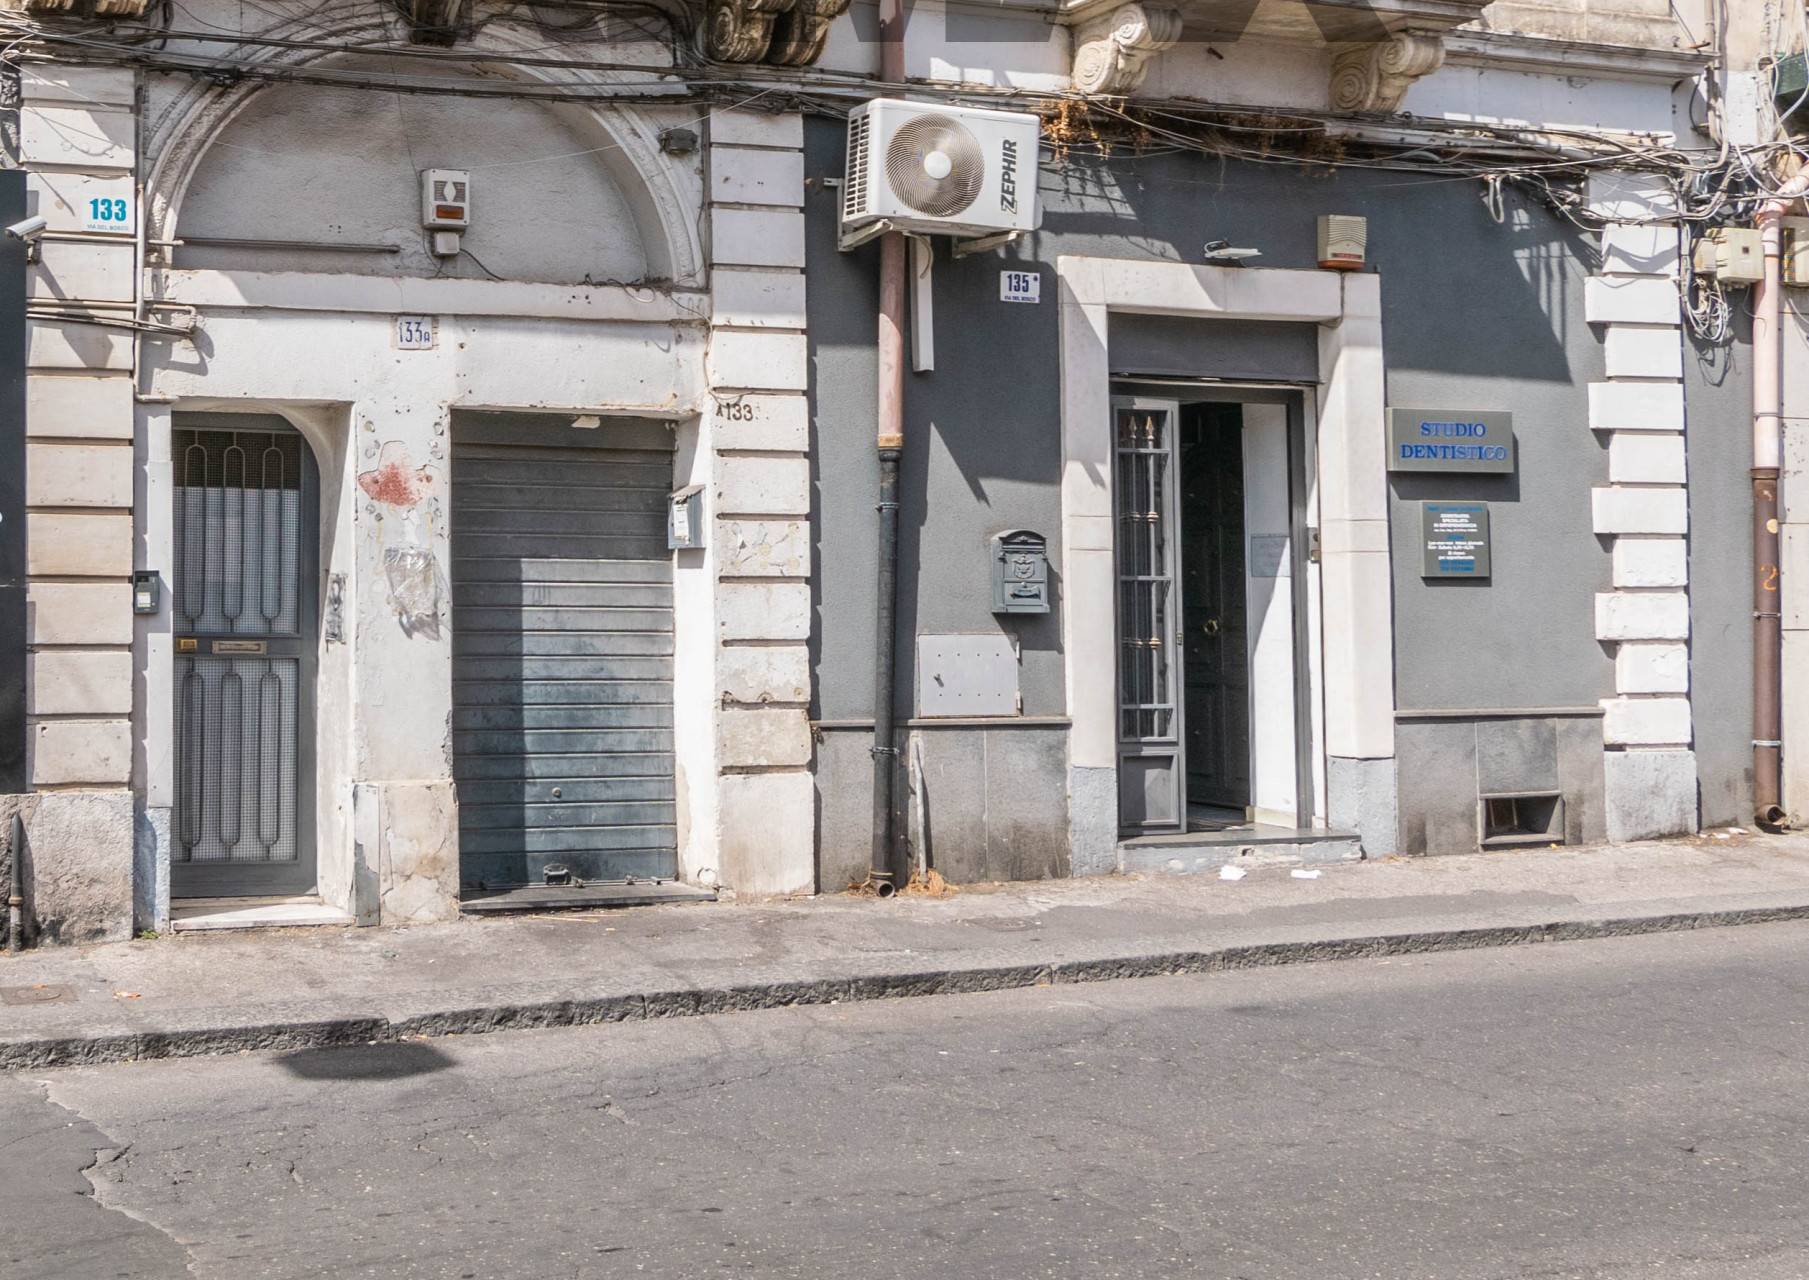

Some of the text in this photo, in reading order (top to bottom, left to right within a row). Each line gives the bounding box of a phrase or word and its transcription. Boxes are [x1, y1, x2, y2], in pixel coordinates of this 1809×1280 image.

[1000, 139, 1017, 214] ZEPHIR
[89, 198, 126, 222] 133
[1007, 274, 1030, 293] 135
[1420, 422, 1487, 437] STUDIO
[1400, 443, 1508, 461] DENTISTICO
